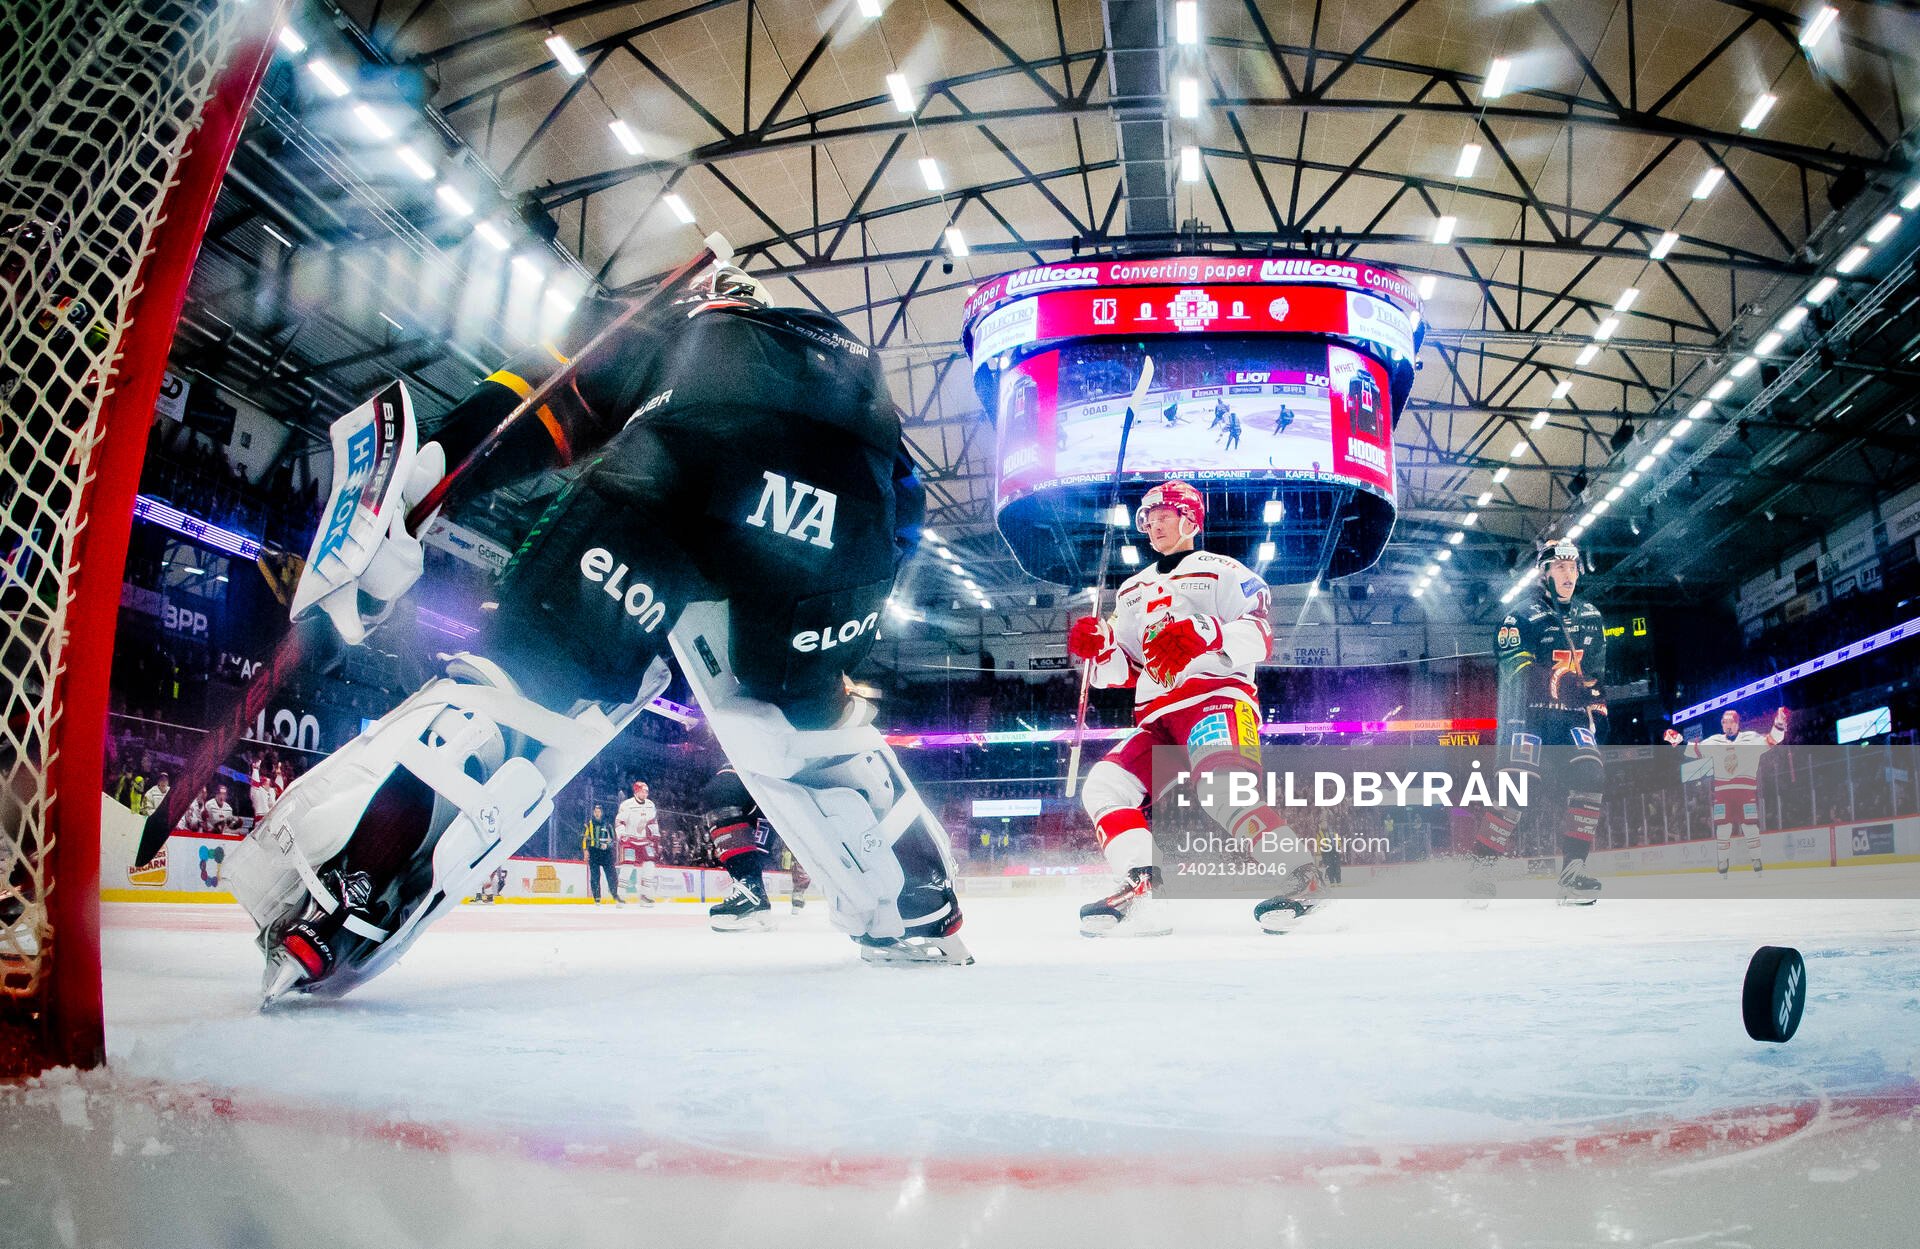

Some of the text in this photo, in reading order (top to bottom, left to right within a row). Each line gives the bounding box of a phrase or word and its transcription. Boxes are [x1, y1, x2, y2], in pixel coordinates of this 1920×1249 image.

[1110, 262, 1198, 281] Converting
[1204, 264, 1254, 281] paper
[1166, 300, 1219, 318] 15:20
[1235, 372, 1271, 384] EJOT
[1348, 437, 1387, 470] HOODIE
[1033, 470, 1362, 491] KAFFE KOMPANIET KAFFE KOMPANIET KAFFE KOMPANIET
[746, 470, 838, 550] NA
[1294, 647, 1332, 657] TRAVEL
[1294, 656, 1324, 665] TEAM
[1450, 734, 1480, 747] VIEW
[1779, 963, 1801, 1035] SHL
